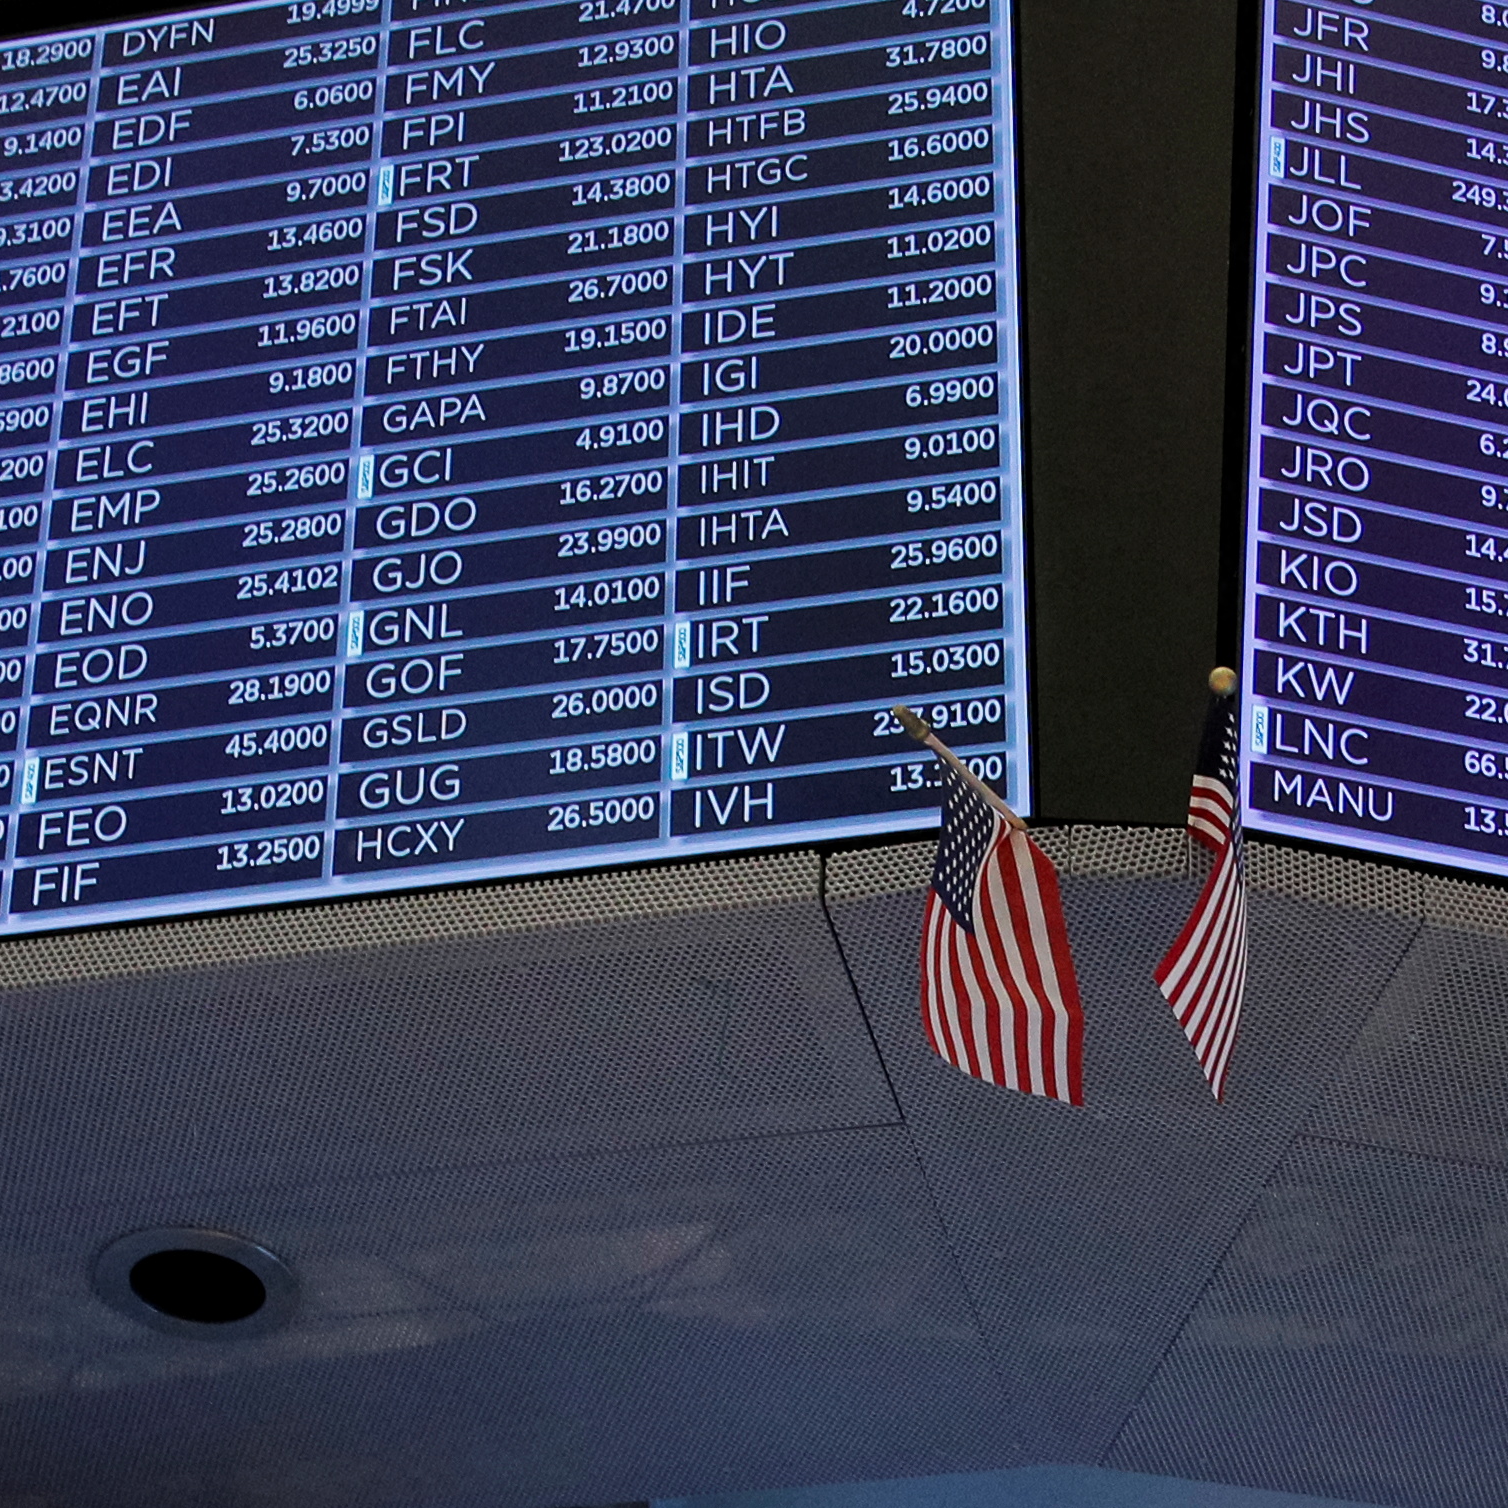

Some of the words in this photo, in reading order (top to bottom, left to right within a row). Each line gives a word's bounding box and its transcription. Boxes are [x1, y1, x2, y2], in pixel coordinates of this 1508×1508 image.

[1292, 6, 1369, 52] JFR
[116, 65, 181, 105] EAI
[282, 34, 377, 68] 25.3250
[708, 63, 794, 105] HTA
[884, 34, 987, 67] 31.7800
[401, 110, 465, 150] FPI
[572, 79, 673, 114] 11.2100
[1288, 145, 1362, 190] JLL
[101, 200, 182, 242] EEA
[285, 170, 366, 202] 9.7000
[392, 247, 473, 291] FSK
[566, 219, 669, 254] 21.1800
[1284, 291, 1362, 336] JPS
[702, 355, 757, 396] IGI
[888, 323, 993, 359] 20.0000
[80, 390, 148, 433] EHI
[268, 360, 353, 393] 9.1800
[382, 392, 486, 433] GAPA
[578, 367, 666, 399] 9.8700
[69, 488, 161, 533] EMP
[245, 460, 346, 496] 25.2600
[1279, 444, 1369, 491] JRO
[699, 507, 789, 547] IHTA
[905, 479, 997, 512] 9.5400
[1279, 548, 1358, 596] KIO
[368, 602, 463, 645] GNL
[553, 574, 660, 611] 14.0100
[697, 614, 769, 659] IRT
[888, 586, 999, 623] 22.1600
[53, 643, 148, 689] EOD
[248, 616, 335, 649] 5.3700
[696, 671, 770, 715] ISD
[890, 641, 1000, 678] 15.0300
[358, 763, 460, 809] GUG
[548, 738, 656, 775] 18.5800
[1274, 712, 1369, 765] LNC
[31, 861, 100, 906] FIF
[215, 834, 321, 871] 13.2500
